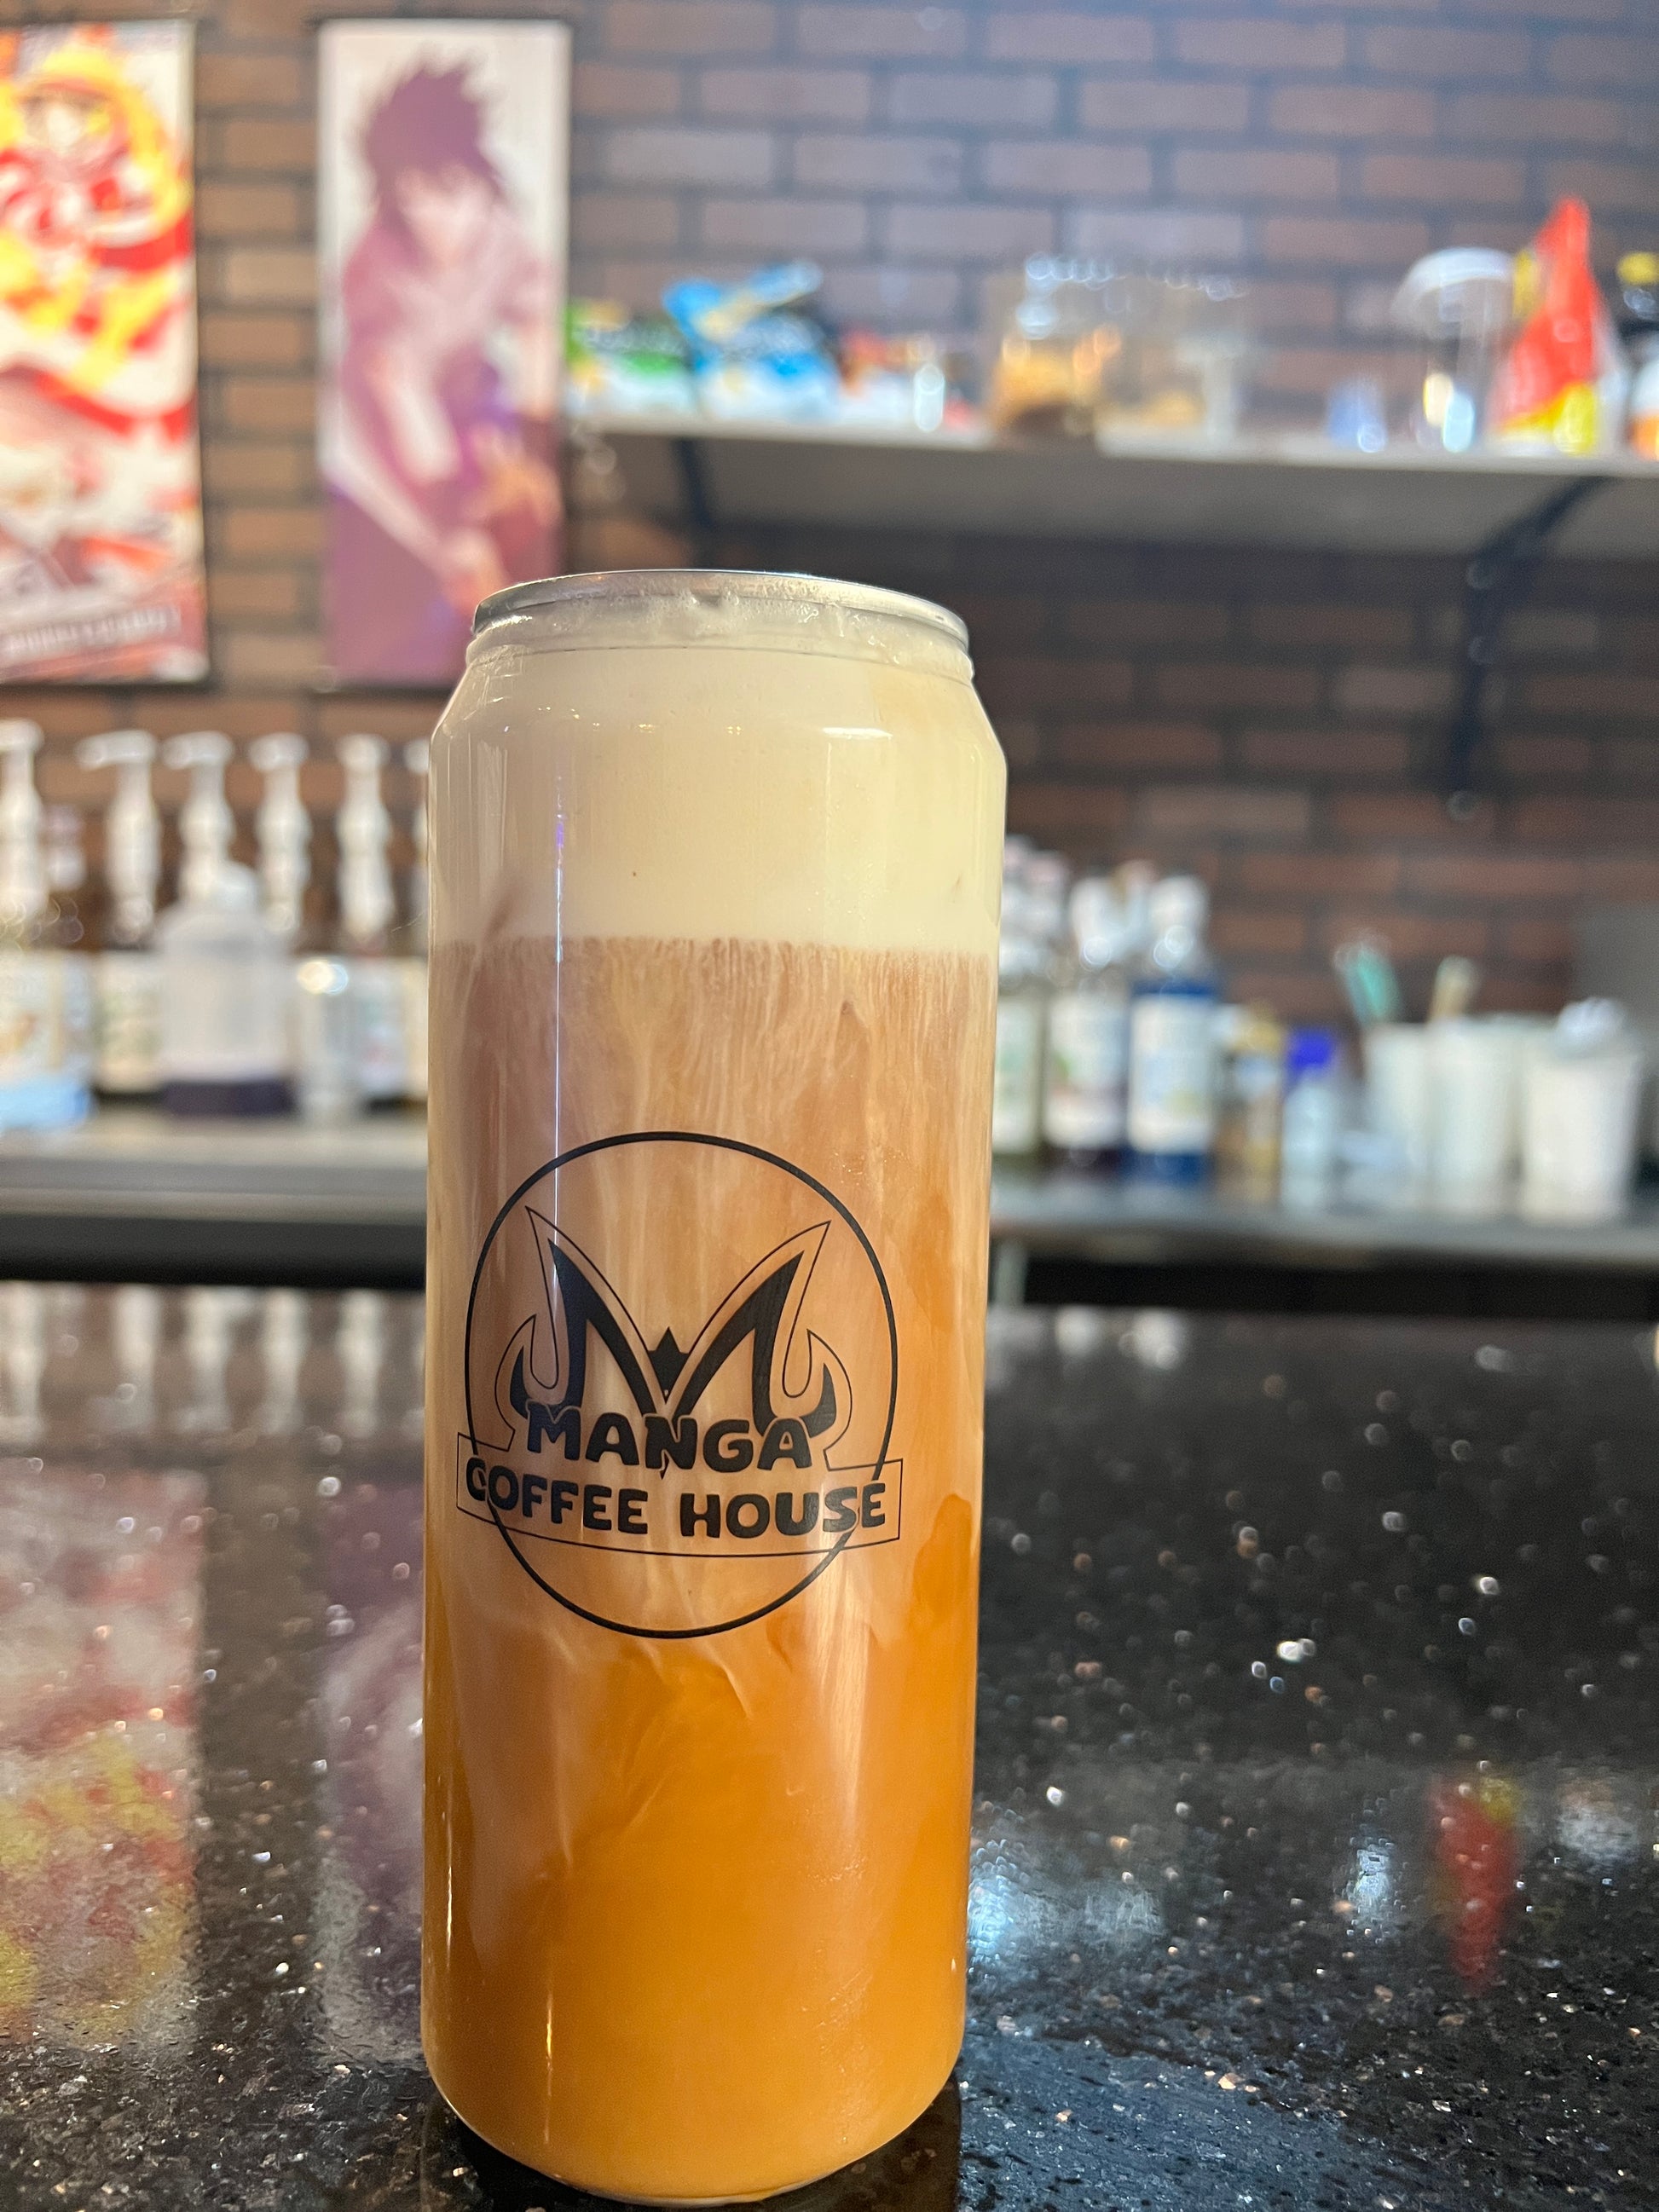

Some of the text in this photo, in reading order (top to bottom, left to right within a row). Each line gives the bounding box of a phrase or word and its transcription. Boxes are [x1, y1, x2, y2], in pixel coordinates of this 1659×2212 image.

[526, 1403, 812, 1473] MANGA
[465, 1458, 886, 1539] COFFEE HOUSE
